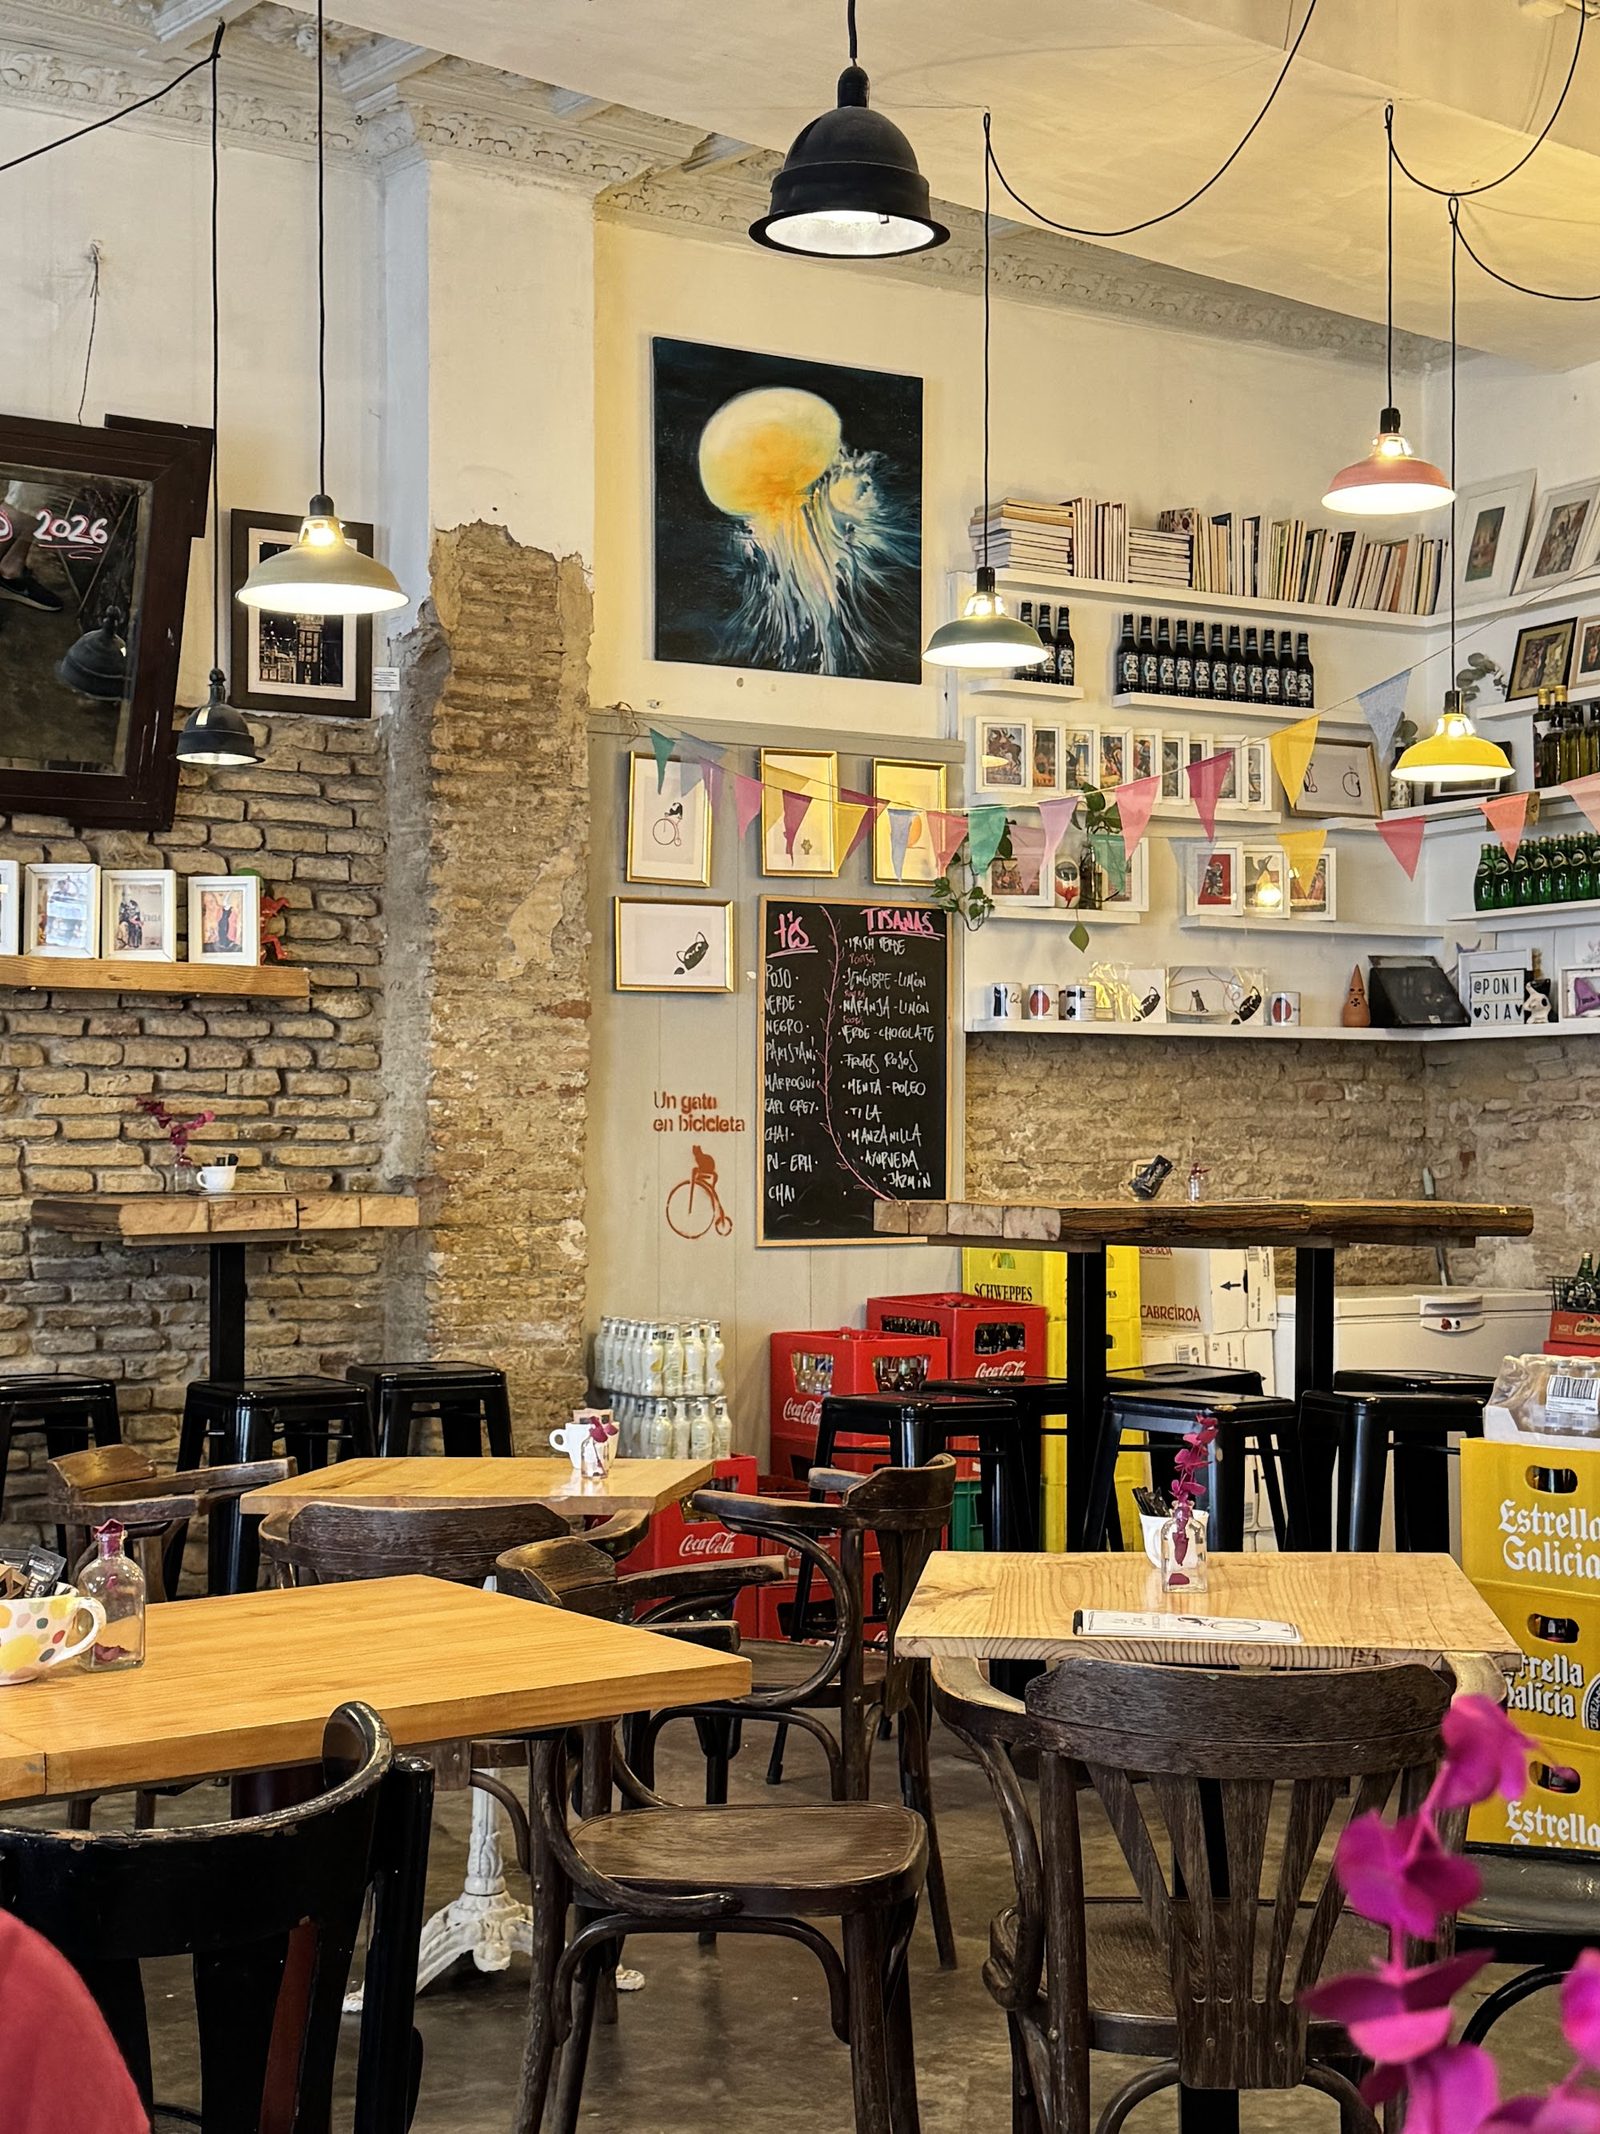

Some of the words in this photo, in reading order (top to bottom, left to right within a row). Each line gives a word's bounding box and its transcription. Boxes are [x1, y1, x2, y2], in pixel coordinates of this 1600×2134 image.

[33, 509, 108, 544] 2026
[860, 908, 934, 934] TISANAS
[1473, 976, 1517, 996] @PONI
[843, 995, 890, 1019] NARANJA
[766, 1019, 803, 1036] NEGRO
[847, 1078, 882, 1096] MENTA
[653, 1091, 677, 1109] Un
[681, 1093, 717, 1114] gato
[652, 1117, 674, 1132] en
[678, 1114, 746, 1133] bicicleta
[765, 1125, 789, 1144] CHAI
[851, 1123, 922, 1147] MANZANILLA
[865, 1149, 919, 1170] AYURVEDA
[768, 1183, 795, 1207] CHAI
[974, 1282, 1033, 1302] SCHWEPPES
[1498, 1499, 1600, 1542] Estrella
[1503, 1535, 1600, 1580] Galicia
[1519, 1653, 1584, 1687] trella
[1505, 1800, 1600, 1848] Estrella
